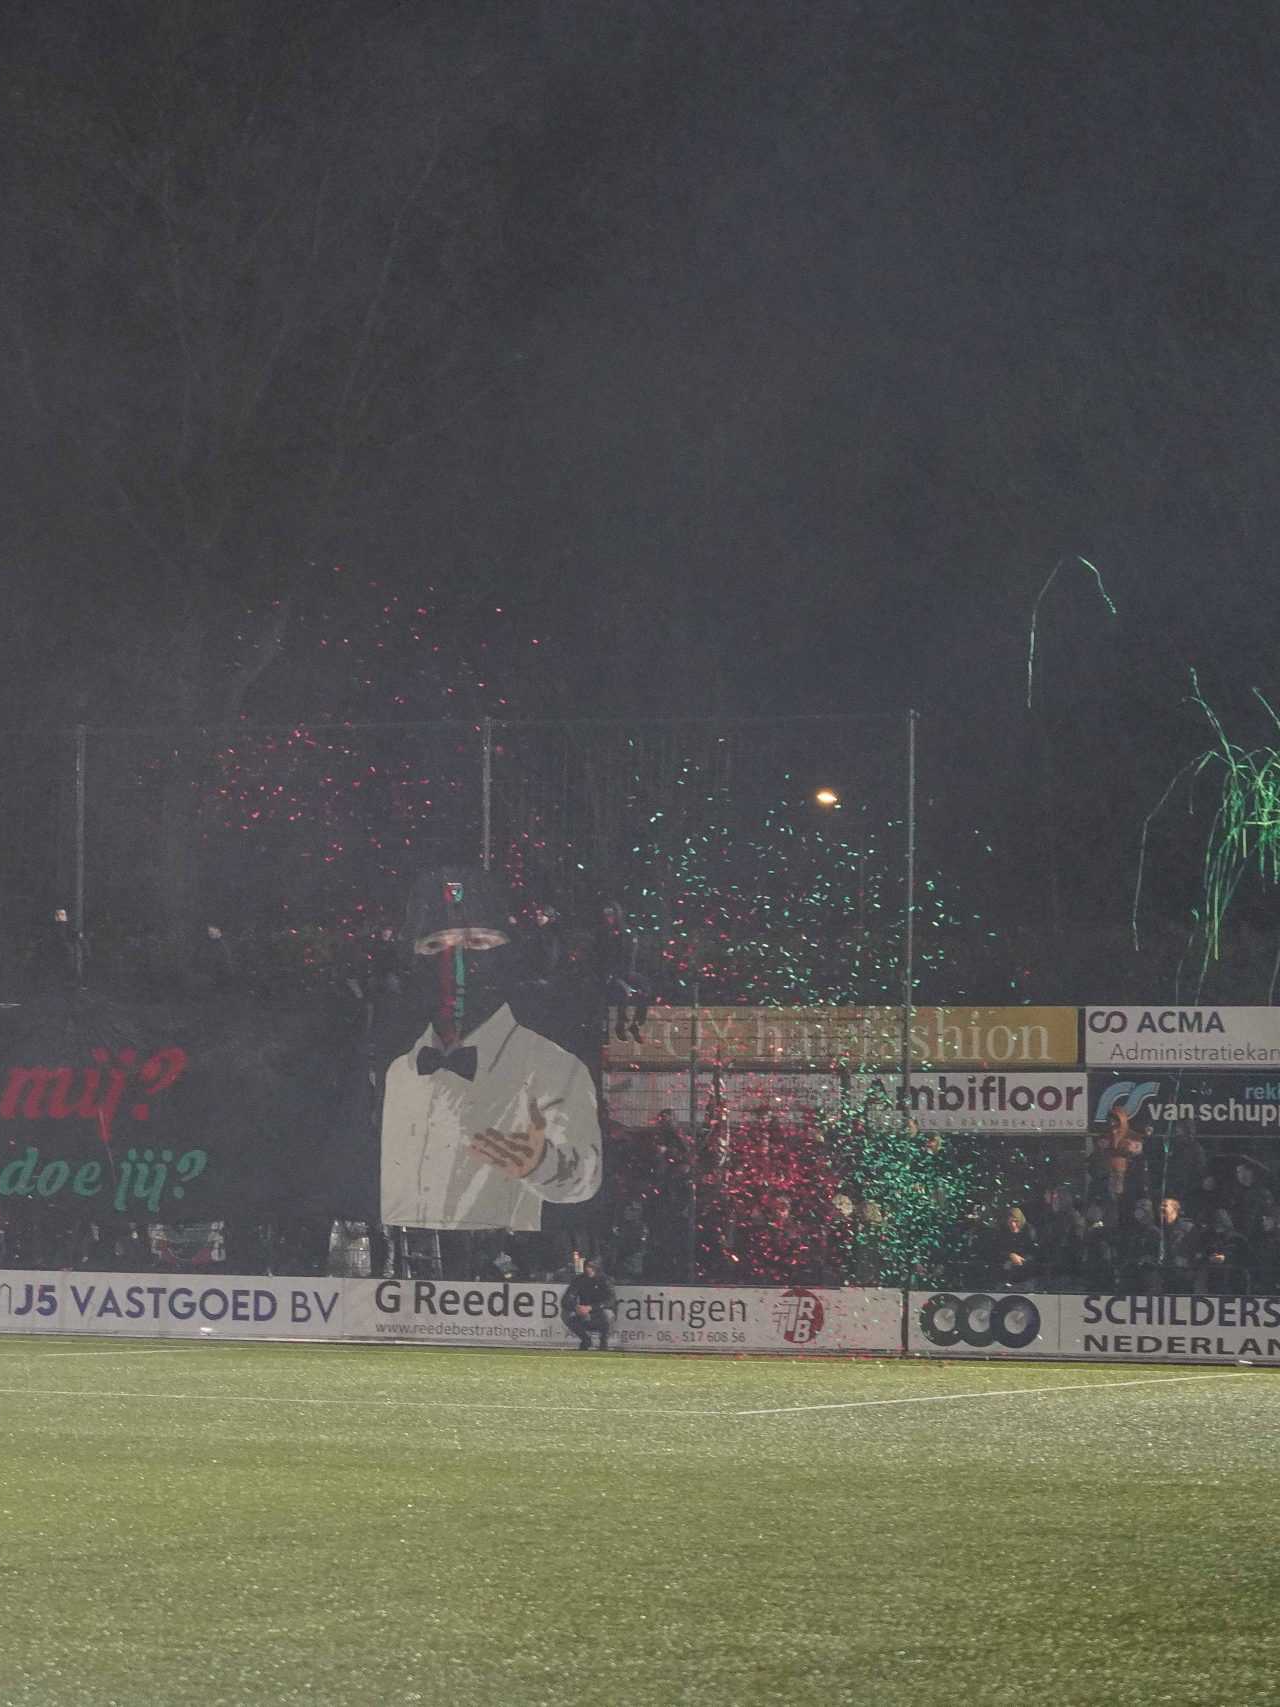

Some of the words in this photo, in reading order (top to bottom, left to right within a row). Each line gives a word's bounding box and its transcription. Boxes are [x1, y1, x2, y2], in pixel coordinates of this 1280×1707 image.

[1137, 1011, 1226, 1033] ACMA
[866, 1076, 1083, 1111] Ambifloor
[1245, 1082, 1280, 1100] rek
[1148, 1102, 1194, 1121] van
[1198, 1098, 1280, 1127] schup
[112, 1148, 208, 1212] jij?
[16, 1284, 59, 1316] J5
[69, 1285, 278, 1322] VASTGOED
[290, 1291, 339, 1323] BV
[375, 1280, 402, 1314] G
[413, 1281, 535, 1318] Reede
